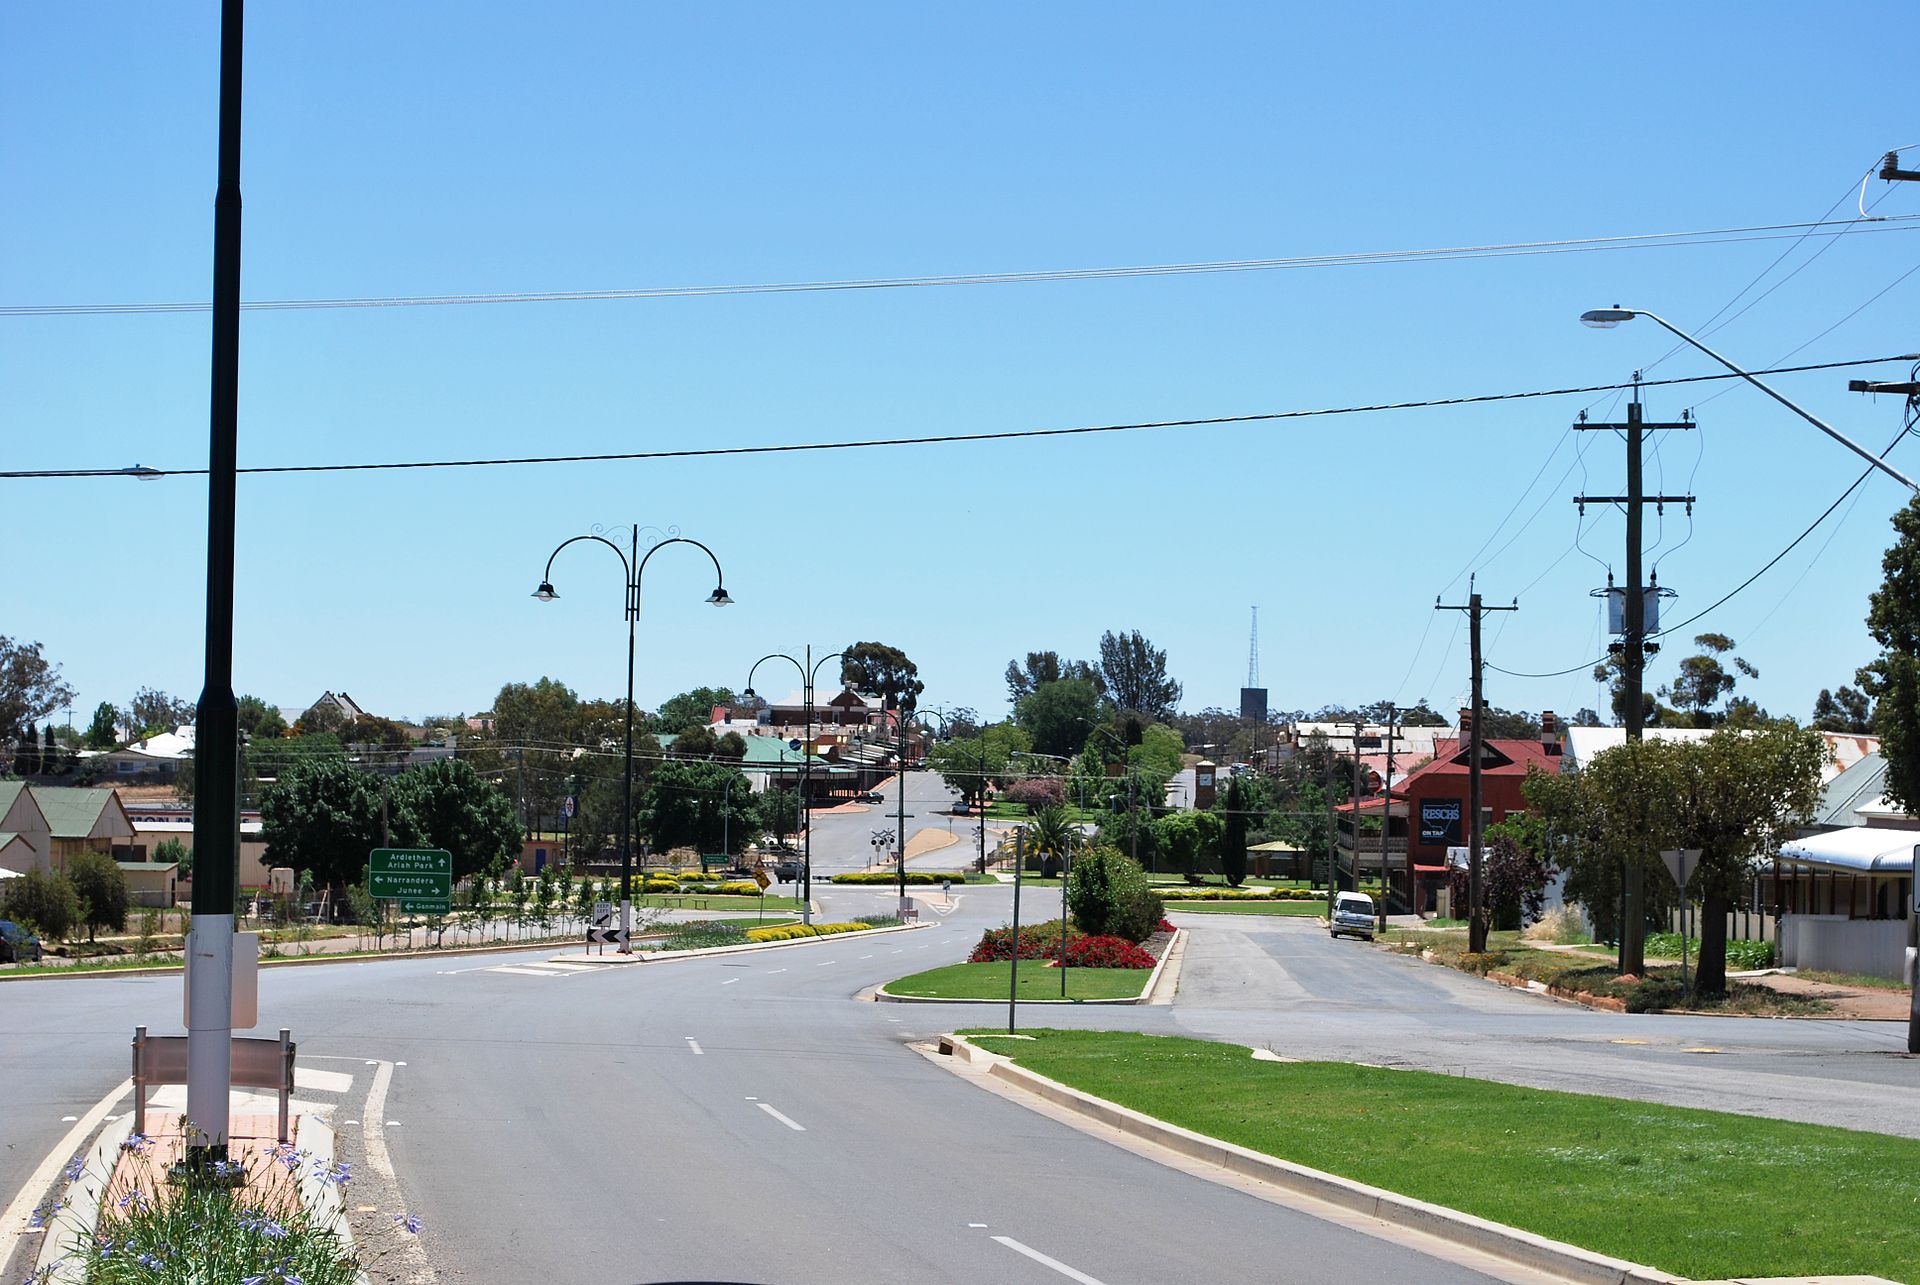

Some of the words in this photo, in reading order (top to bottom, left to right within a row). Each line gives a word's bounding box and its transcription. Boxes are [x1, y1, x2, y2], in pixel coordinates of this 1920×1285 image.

[1423, 808, 1460, 820] RESCHS
[390, 853, 432, 861] Ardlethan
[386, 876, 434, 884] Narrandera
